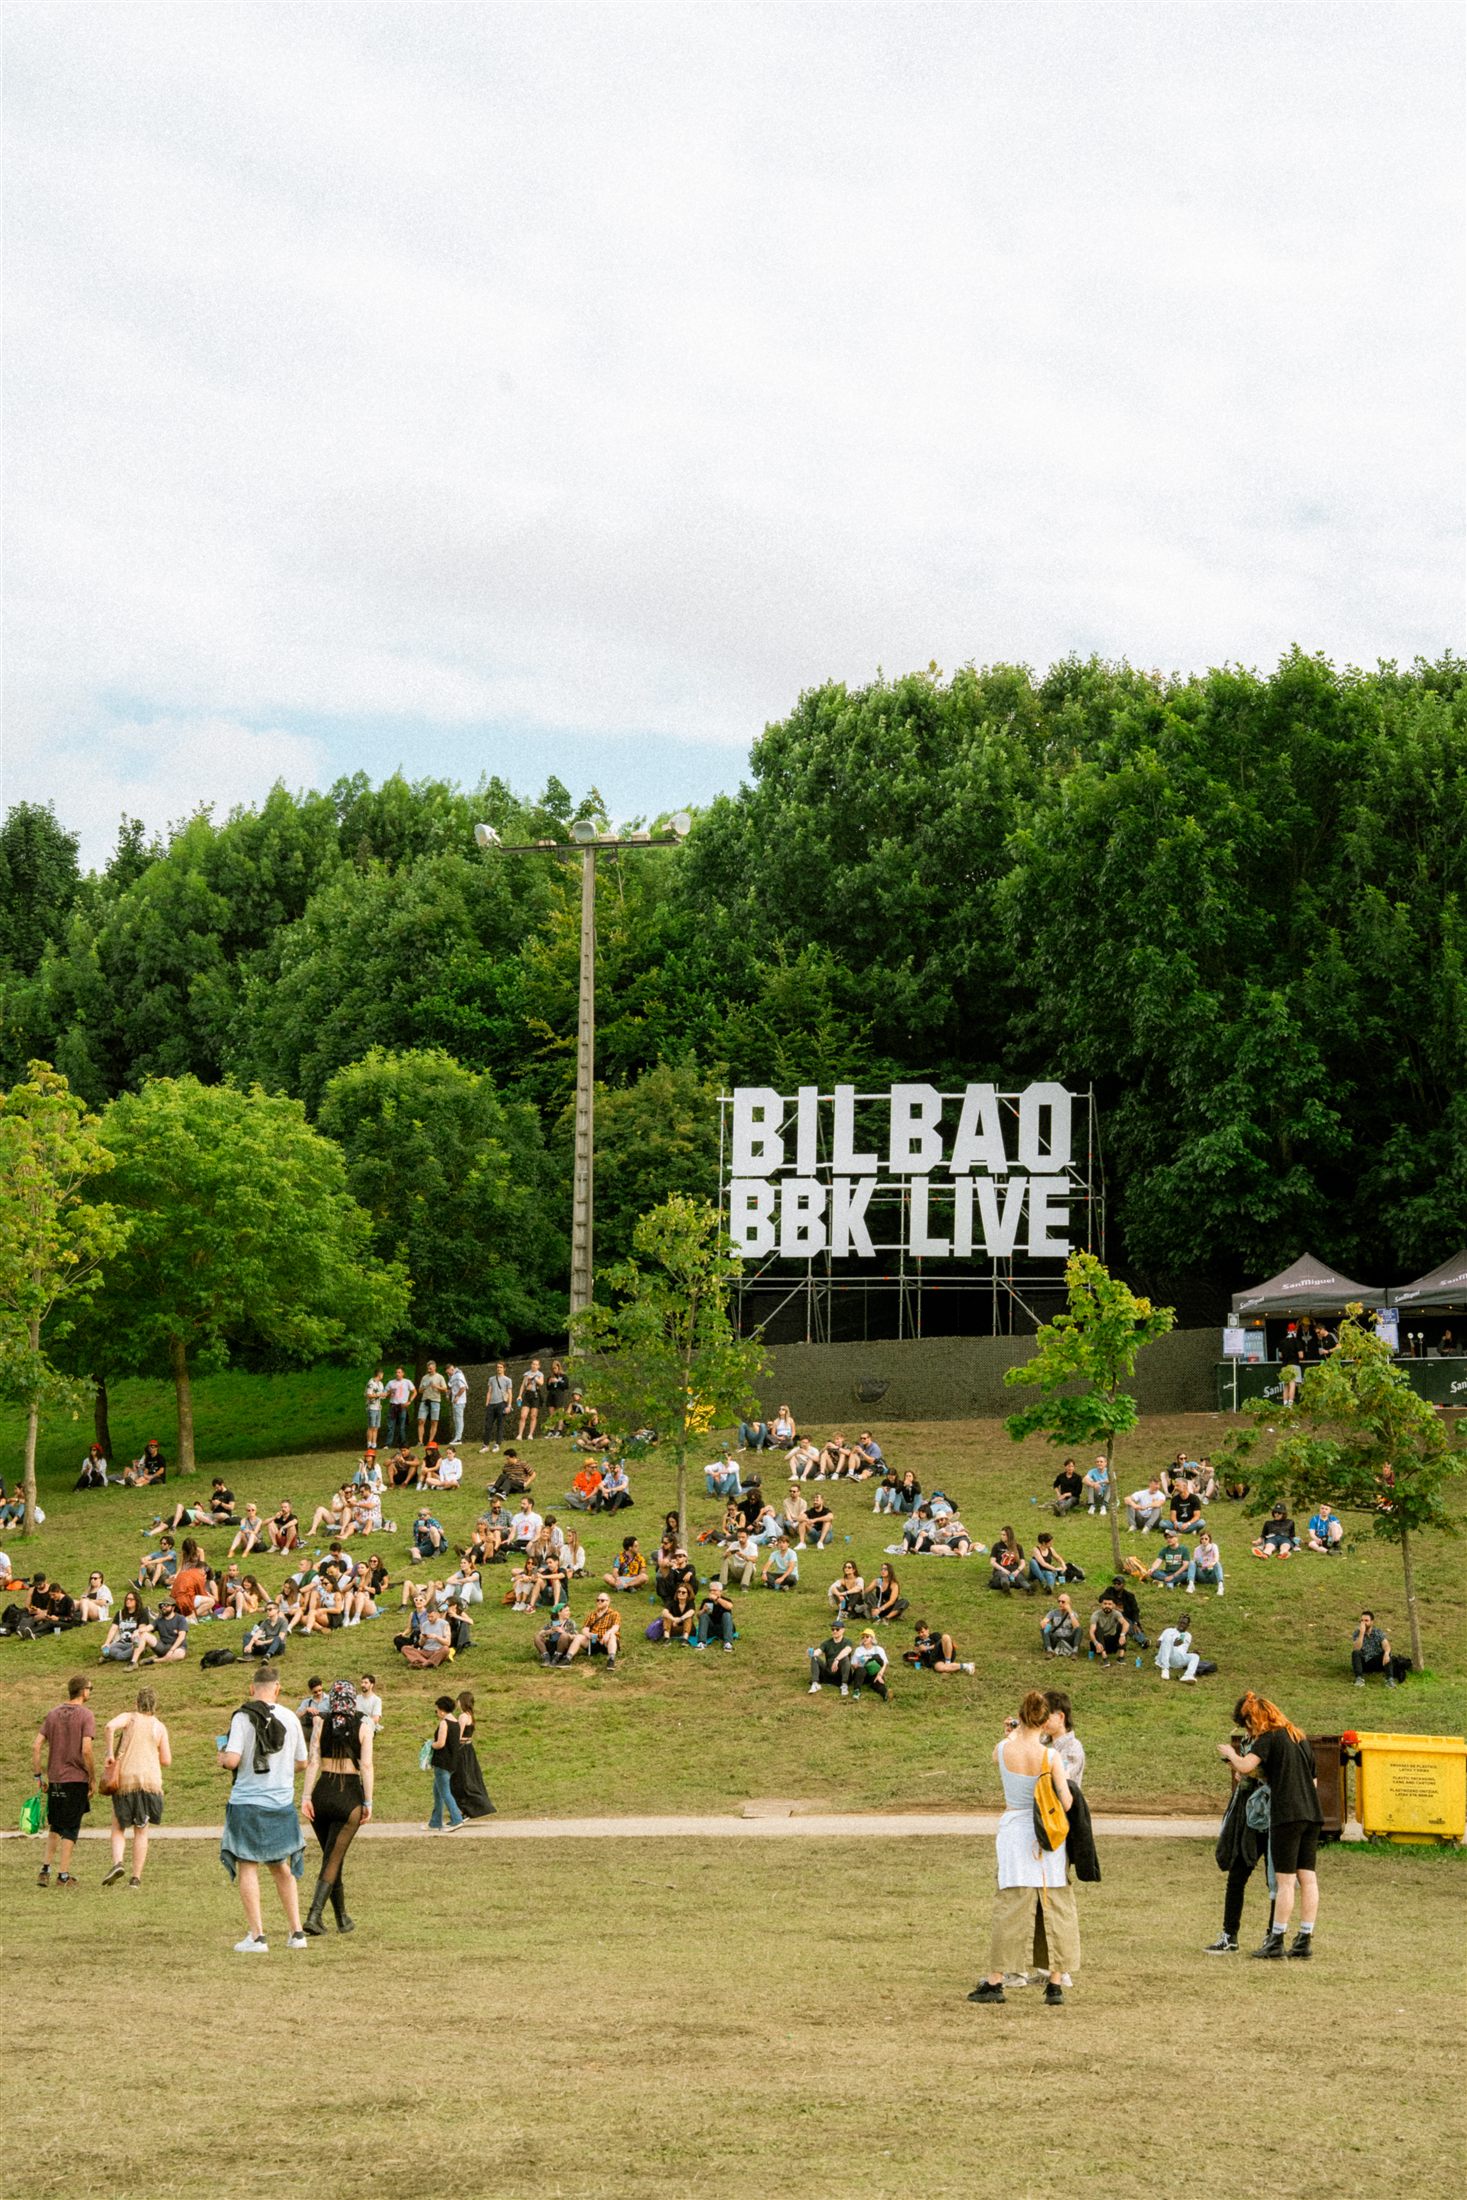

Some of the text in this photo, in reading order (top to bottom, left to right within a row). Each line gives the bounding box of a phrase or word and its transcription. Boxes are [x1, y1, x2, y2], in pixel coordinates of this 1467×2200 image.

[732, 1082, 1072, 1176] BILBAO
[730, 1176, 1070, 1258] BBK LIVE
